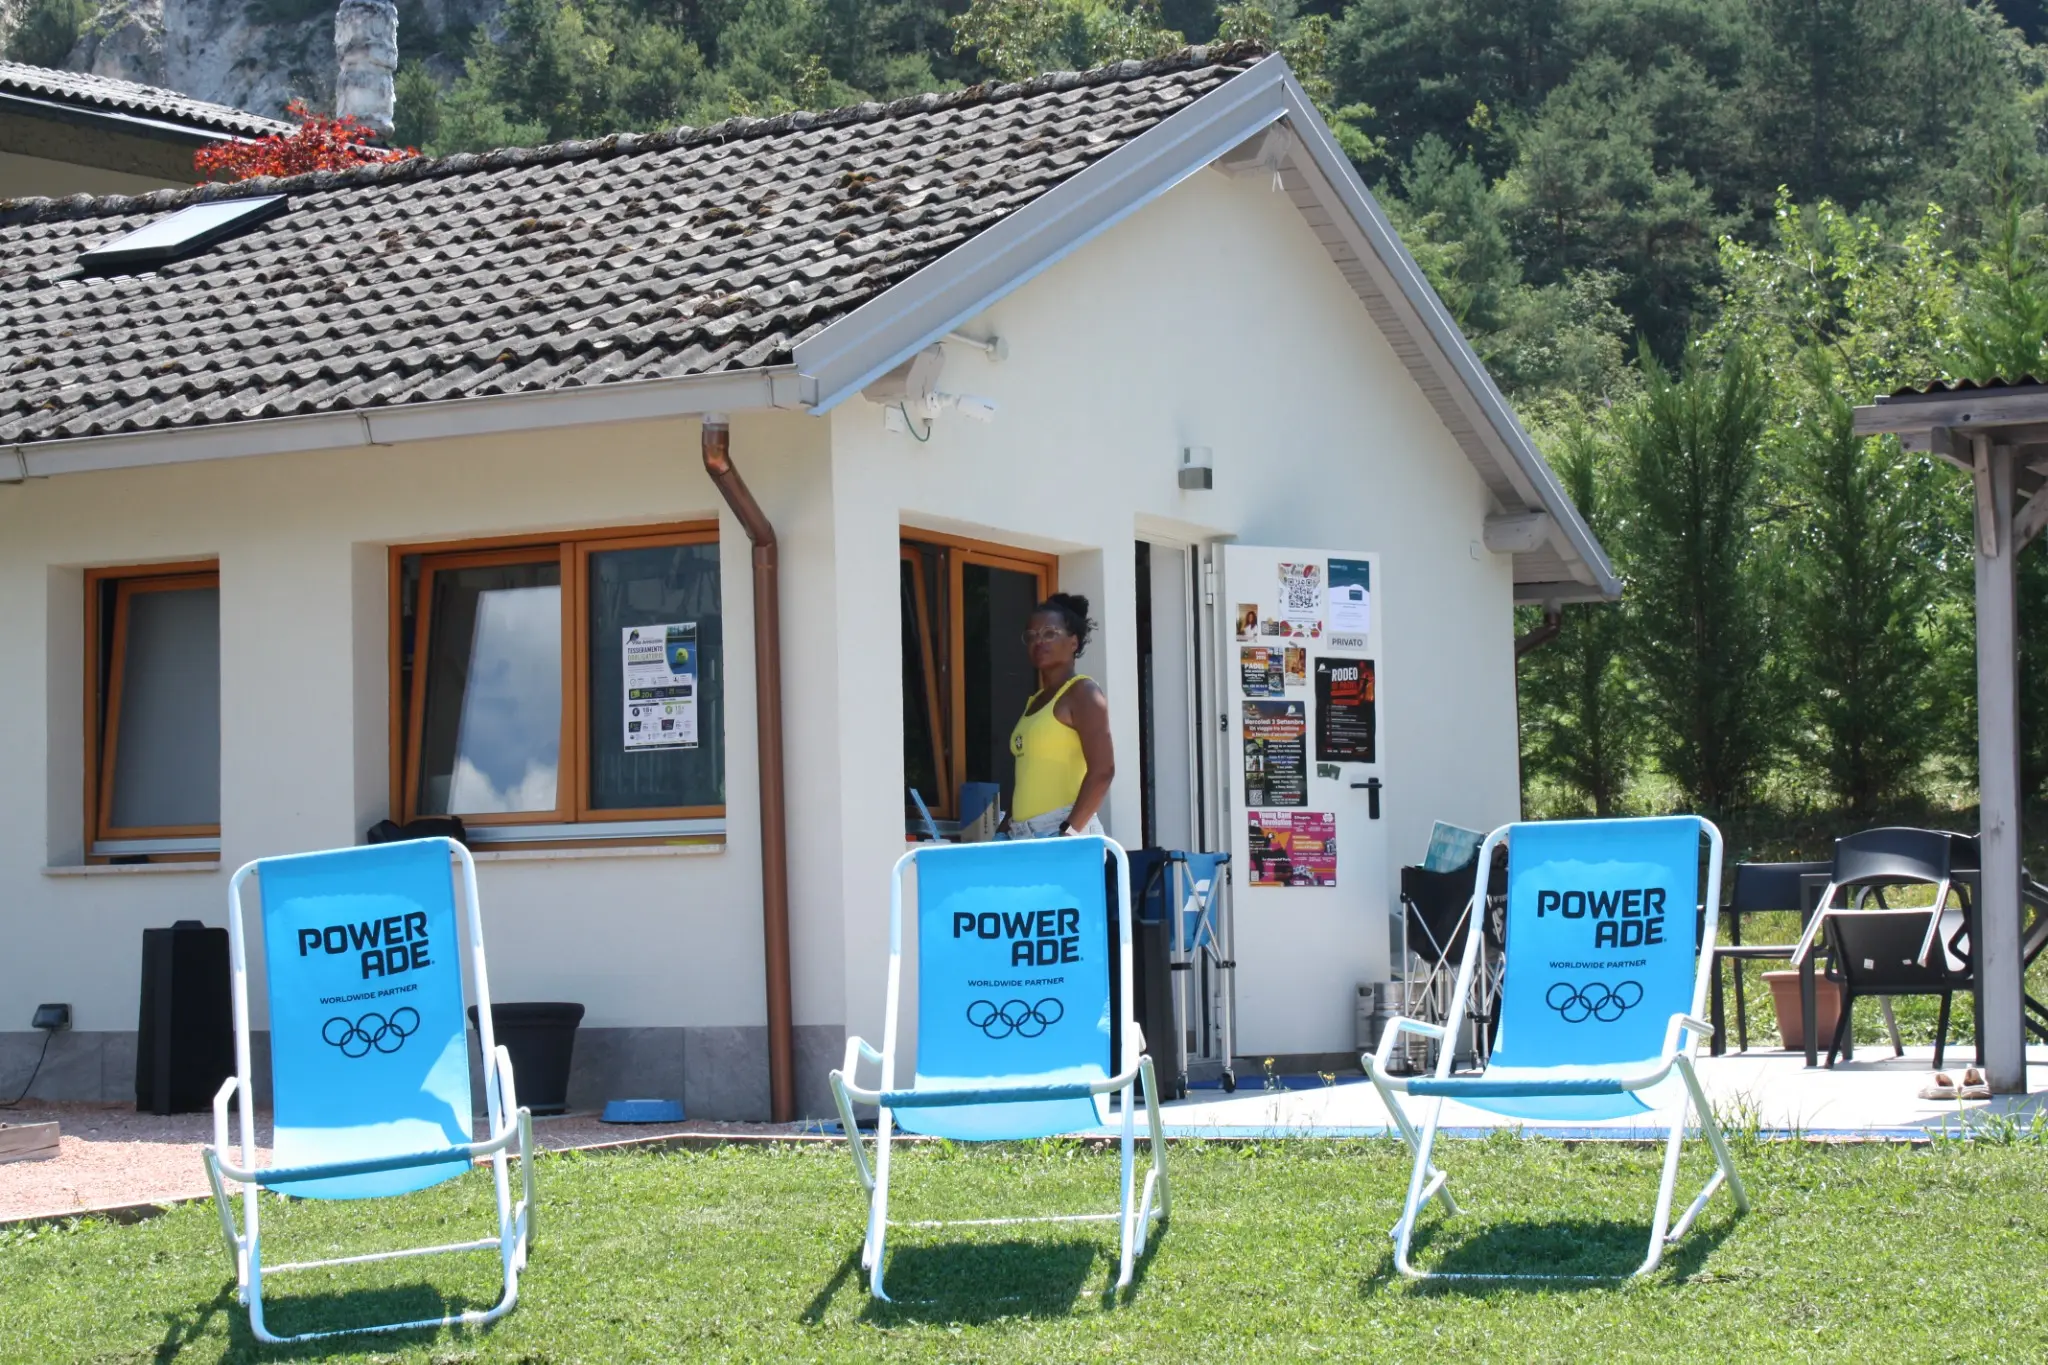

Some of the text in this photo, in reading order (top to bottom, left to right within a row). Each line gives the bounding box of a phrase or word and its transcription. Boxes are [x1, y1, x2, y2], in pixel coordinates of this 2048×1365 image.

[1331, 638, 1363, 647] PRIVATO
[1331, 666, 1358, 682] RODEO
[1537, 887, 1666, 919] POWER
[298, 911, 429, 957] POWER
[953, 908, 1080, 940] POWER
[1595, 916, 1665, 949] ADE
[361, 939, 431, 980] ADE
[1011, 935, 1080, 967] ADE
[1549, 959, 1647, 969] WORLDWIDE PARTNER
[319, 983, 418, 1005] WORLDWIDE PARTNER
[967, 977, 1064, 987] WORLDWIDE PARTNER
